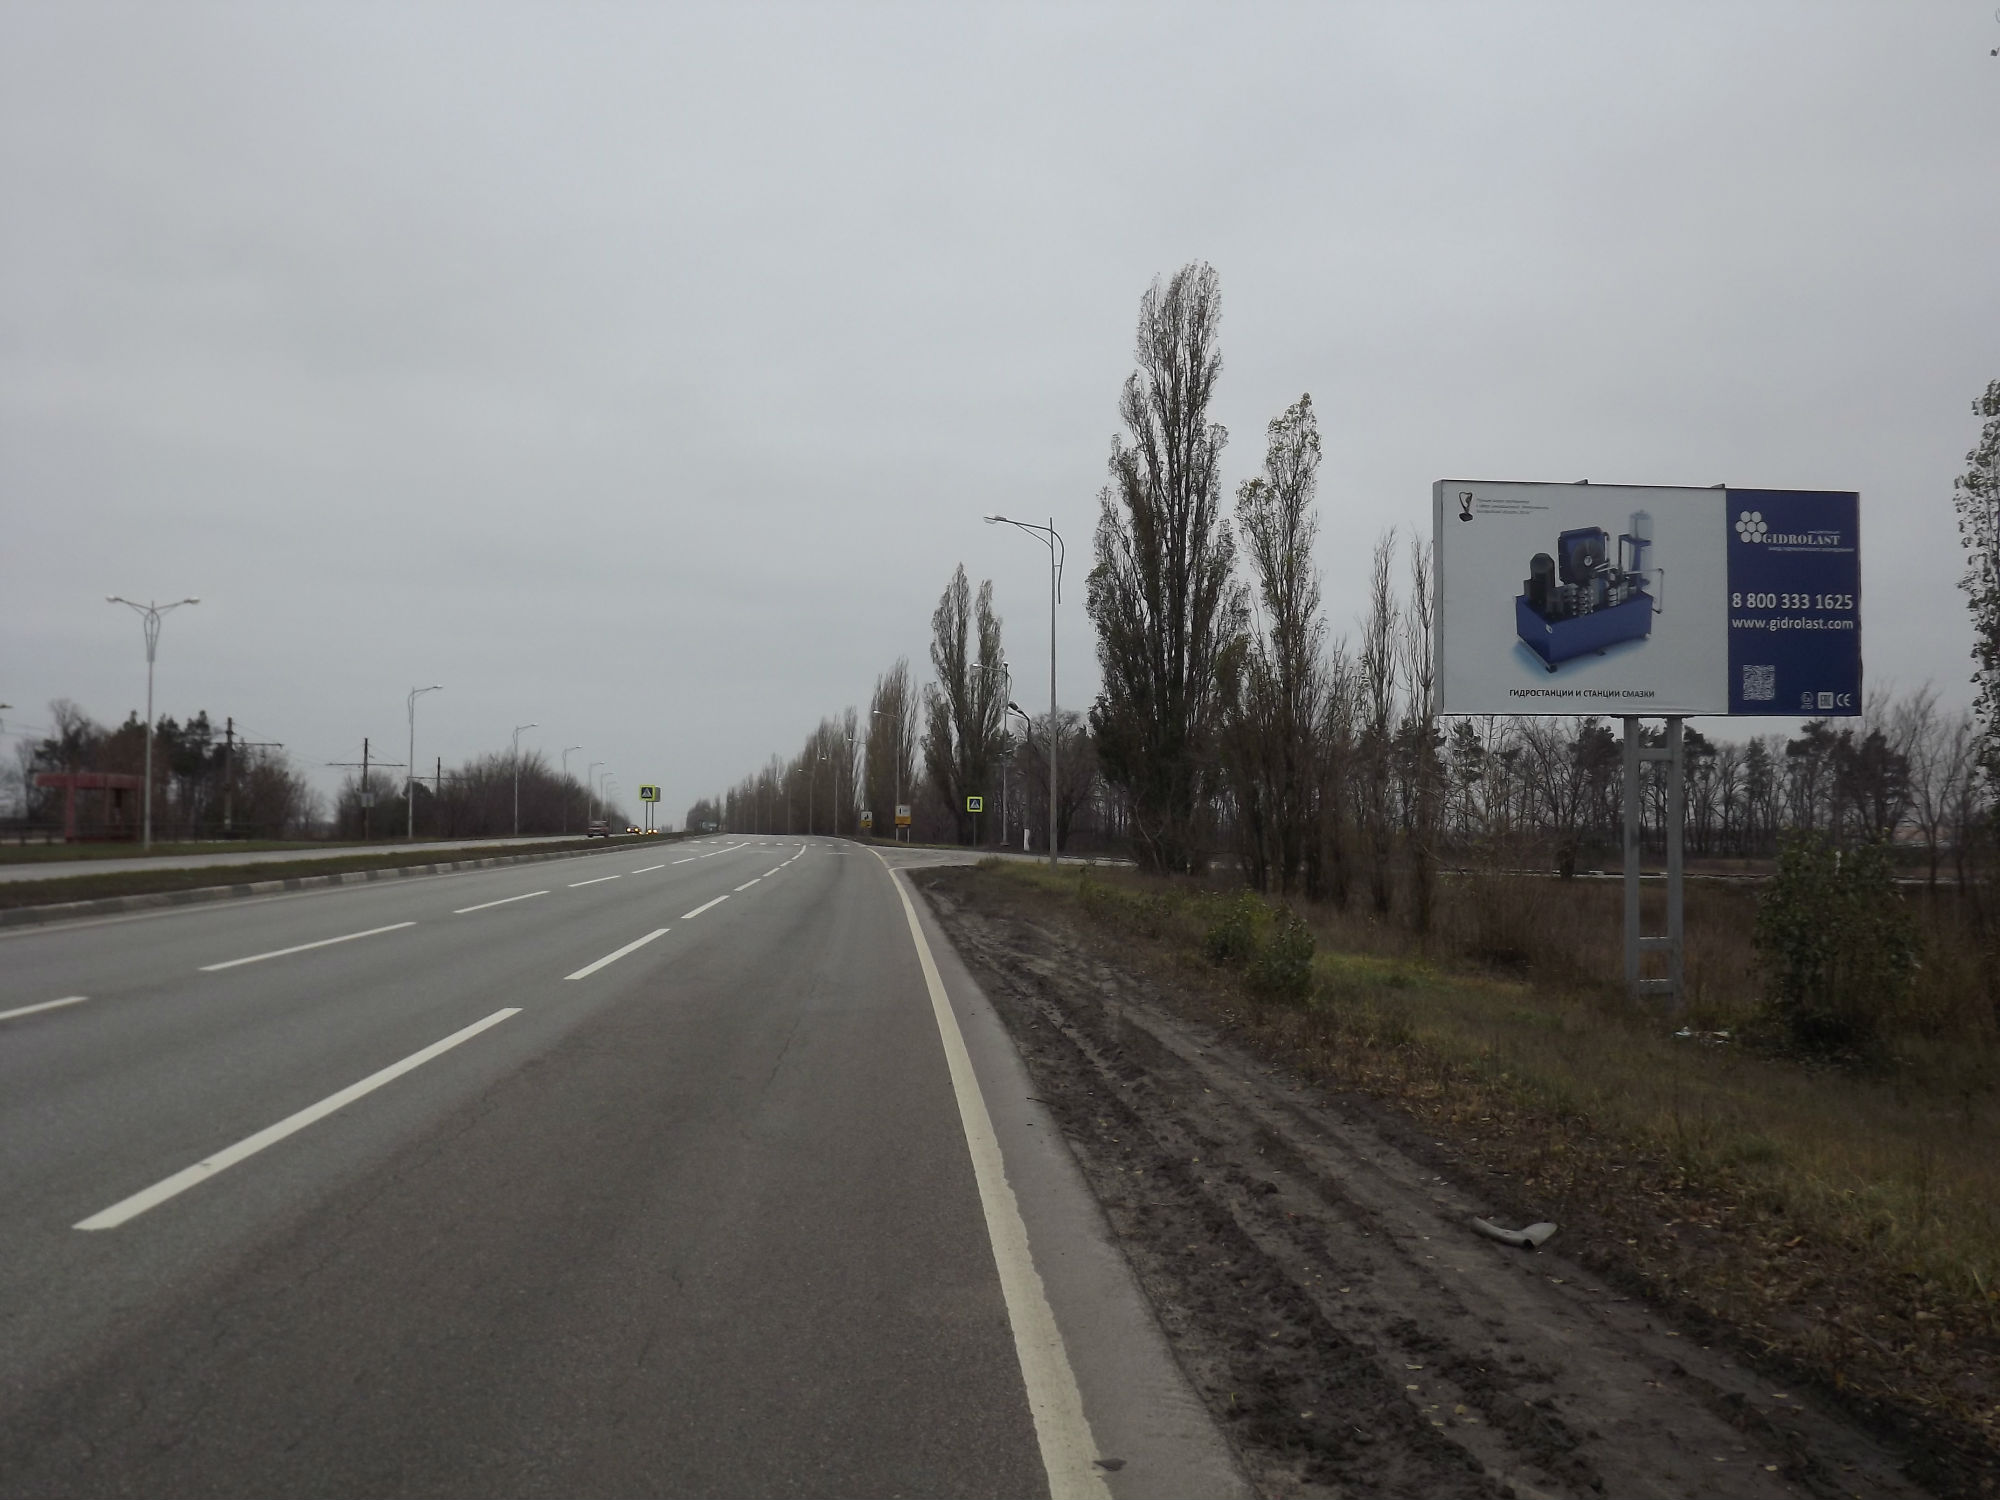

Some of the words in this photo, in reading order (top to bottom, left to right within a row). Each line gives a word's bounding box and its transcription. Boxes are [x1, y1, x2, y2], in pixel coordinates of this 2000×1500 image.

[1762, 533, 1840, 545] GIDROLAST
[1732, 592, 1742, 608] 8
[1746, 593, 1777, 609] 800
[1781, 593, 1810, 609] 333
[1815, 594, 1853, 610] 1625
[1732, 617, 1854, 632] www.gidrolast.com
[1509, 689, 1574, 698] ГИДРОСТАНЦИИ
[1575, 690, 1581, 698] И
[1583, 690, 1620, 698] СТАНЦИИ
[1622, 690, 1655, 698] СМАЗКИ
